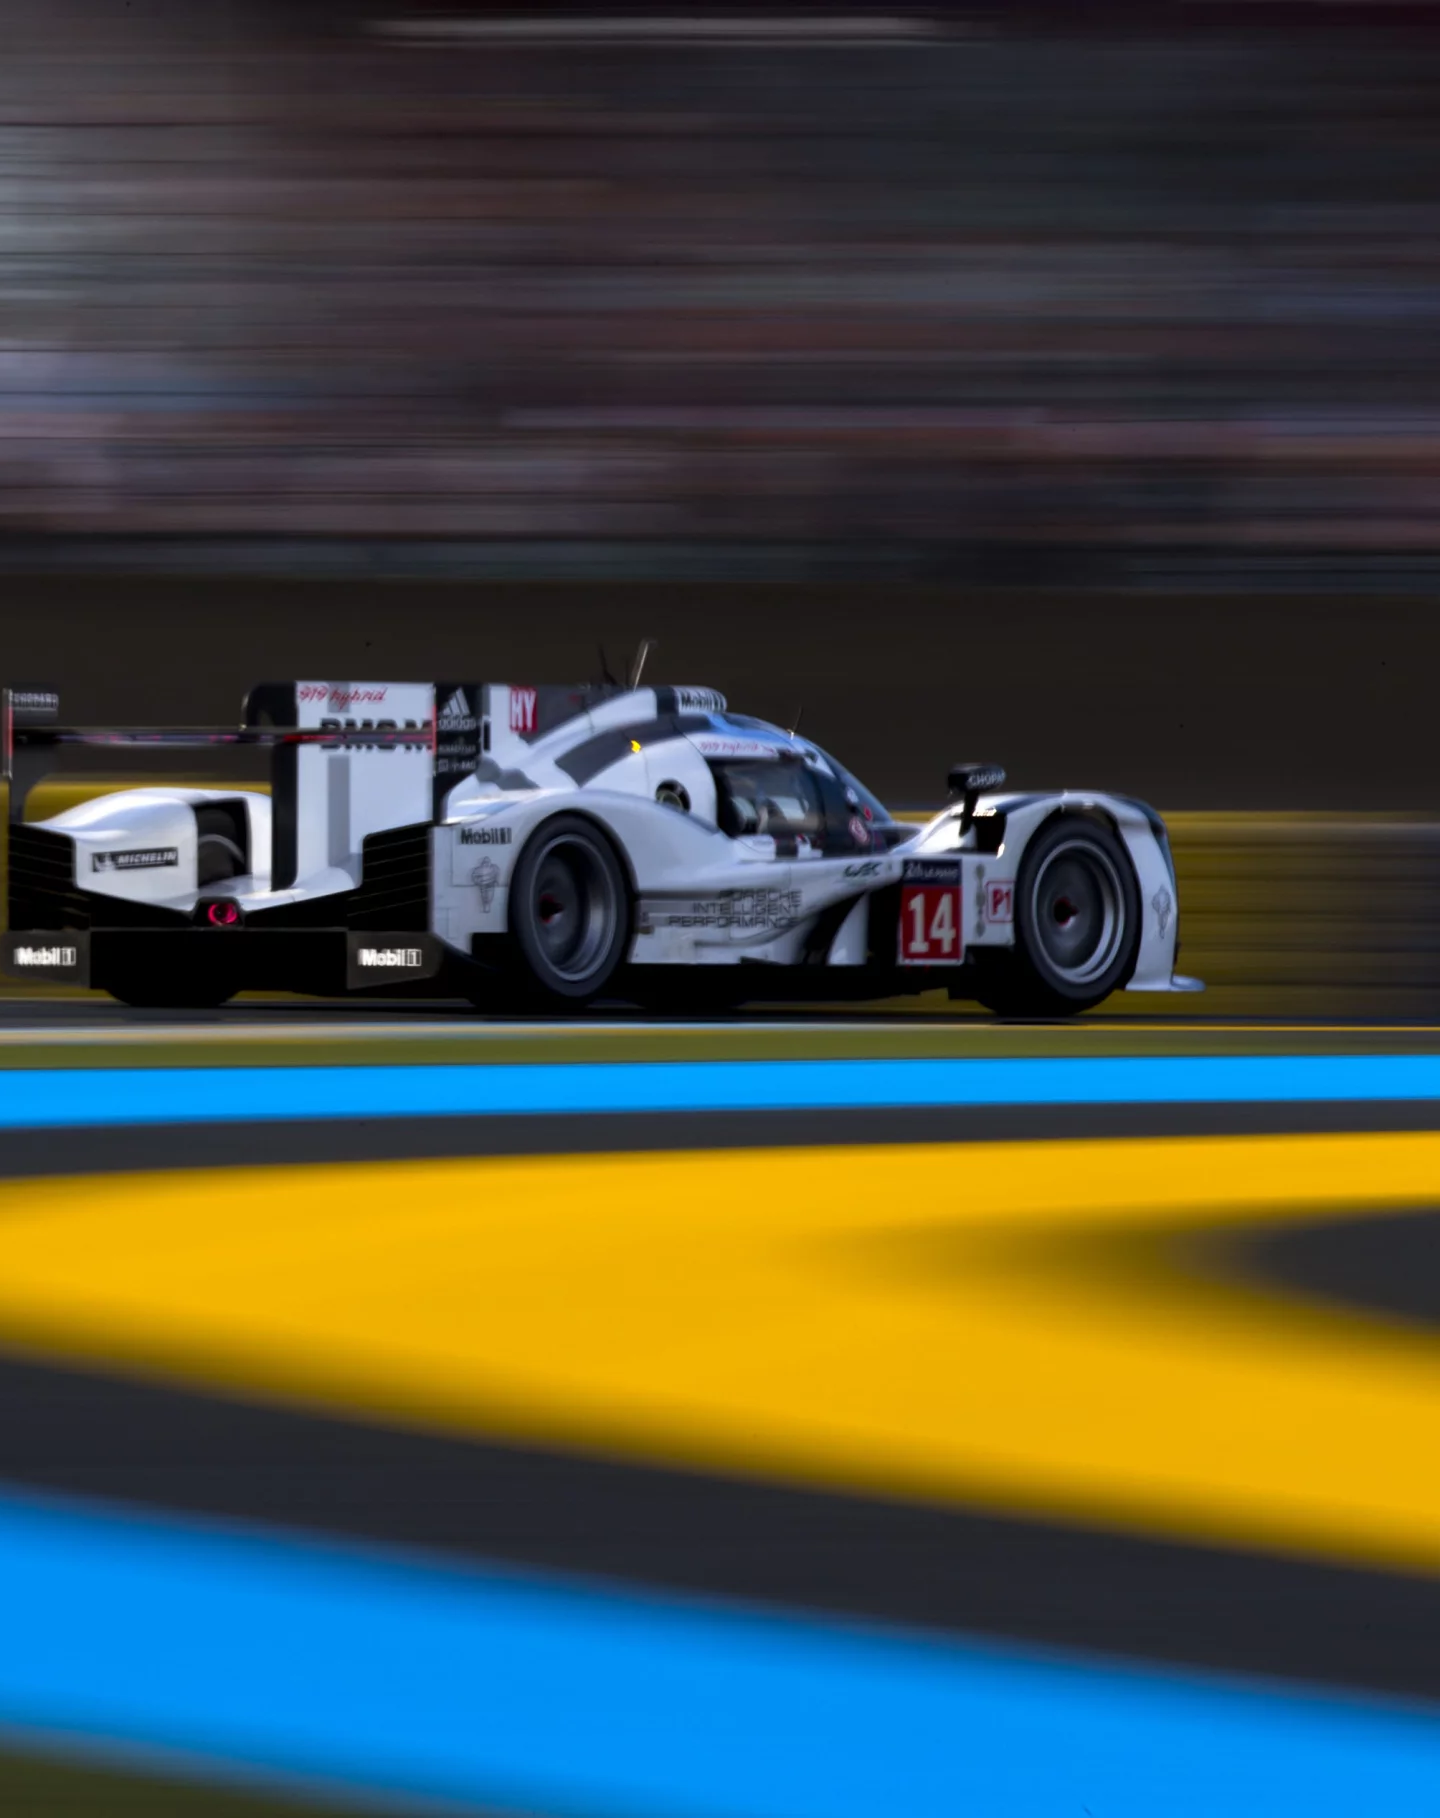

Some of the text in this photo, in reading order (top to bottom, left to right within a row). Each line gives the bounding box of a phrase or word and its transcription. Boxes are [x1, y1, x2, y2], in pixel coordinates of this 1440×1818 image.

[300, 685, 388, 711] 919 hybrid
[511, 692, 536, 730] HY
[438, 716, 477, 731] adidas
[461, 827, 499, 845] Mobil
[118, 851, 177, 865] MICHELIN
[692, 901, 802, 915] INTELLIGENT
[667, 915, 802, 928] PERFORMANCE
[909, 893, 956, 954] 14
[14, 947, 60, 965] Mobil
[358, 948, 405, 966] Mobil
